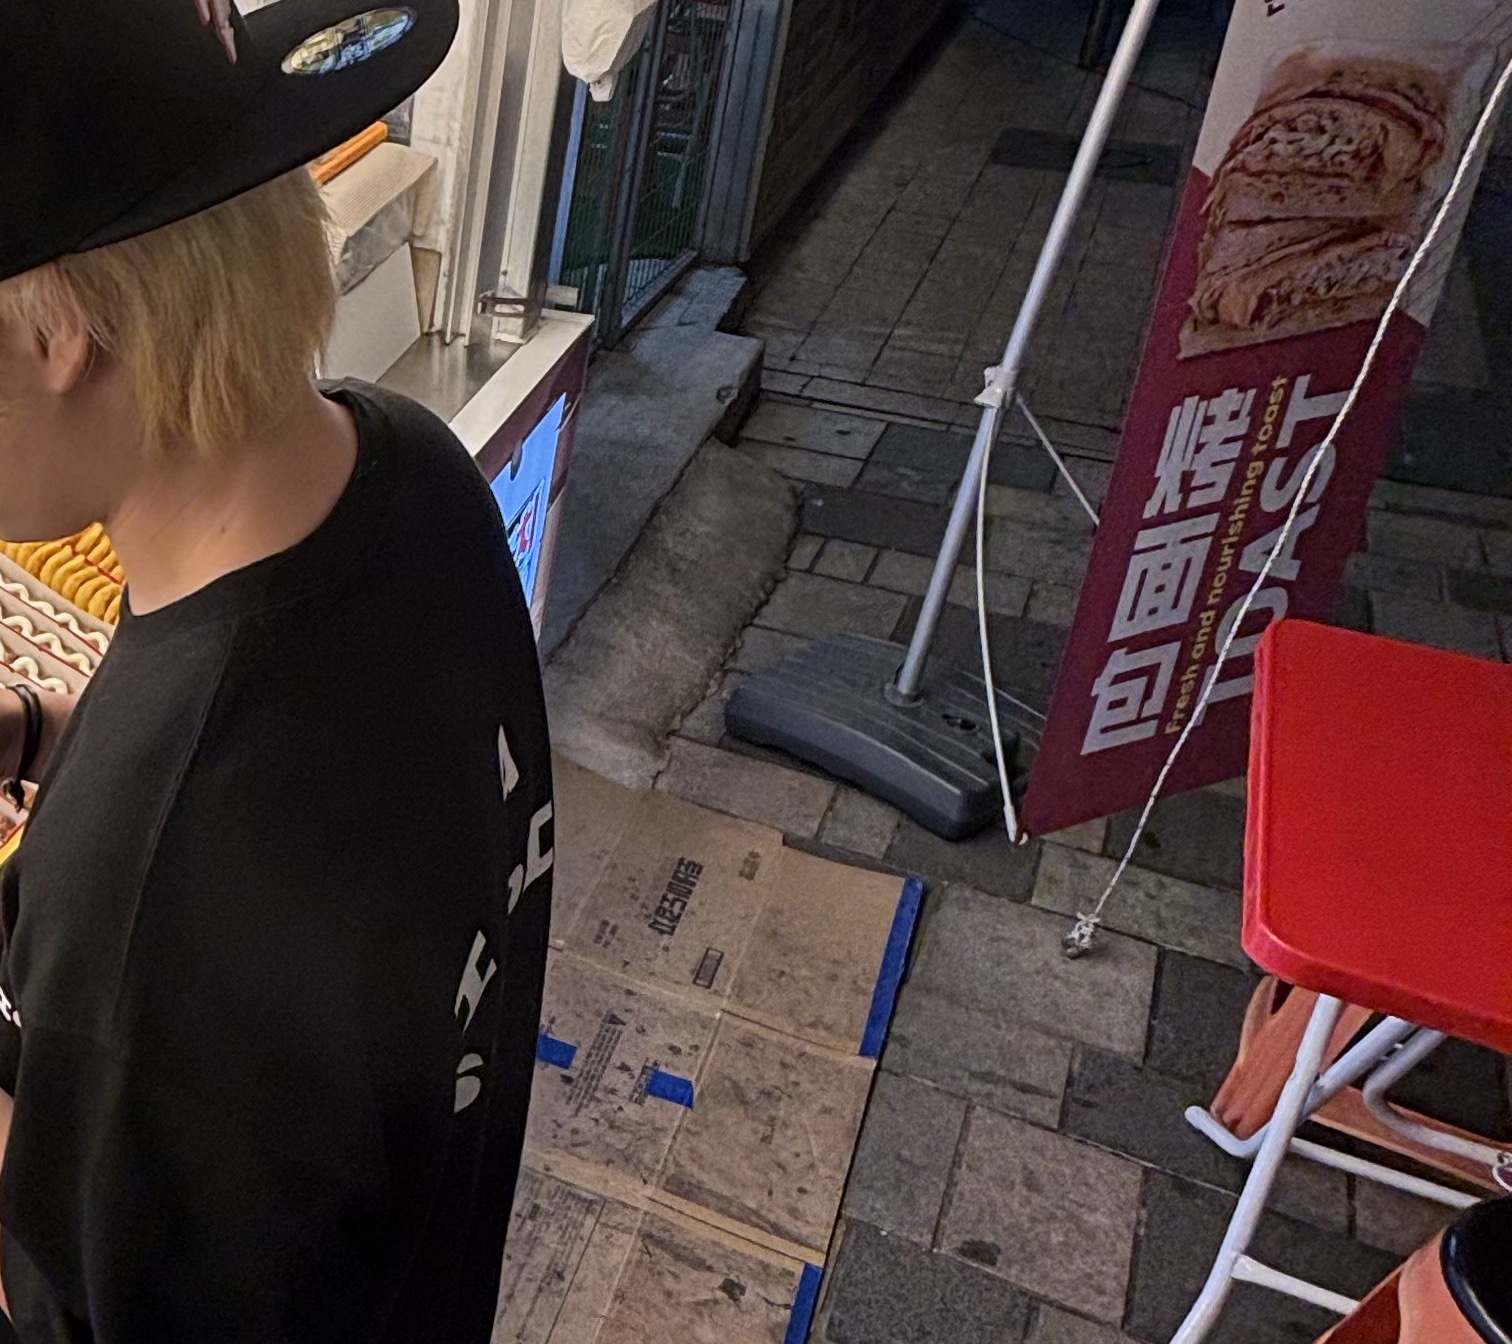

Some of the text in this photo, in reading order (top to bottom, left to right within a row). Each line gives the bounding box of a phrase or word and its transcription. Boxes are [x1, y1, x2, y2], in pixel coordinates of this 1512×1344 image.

[1078, 385, 1257, 757] 烤面包
[1187, 610, 1213, 668] and
[1204, 456, 1264, 612] nourishing
[1247, 373, 1290, 458] toast
